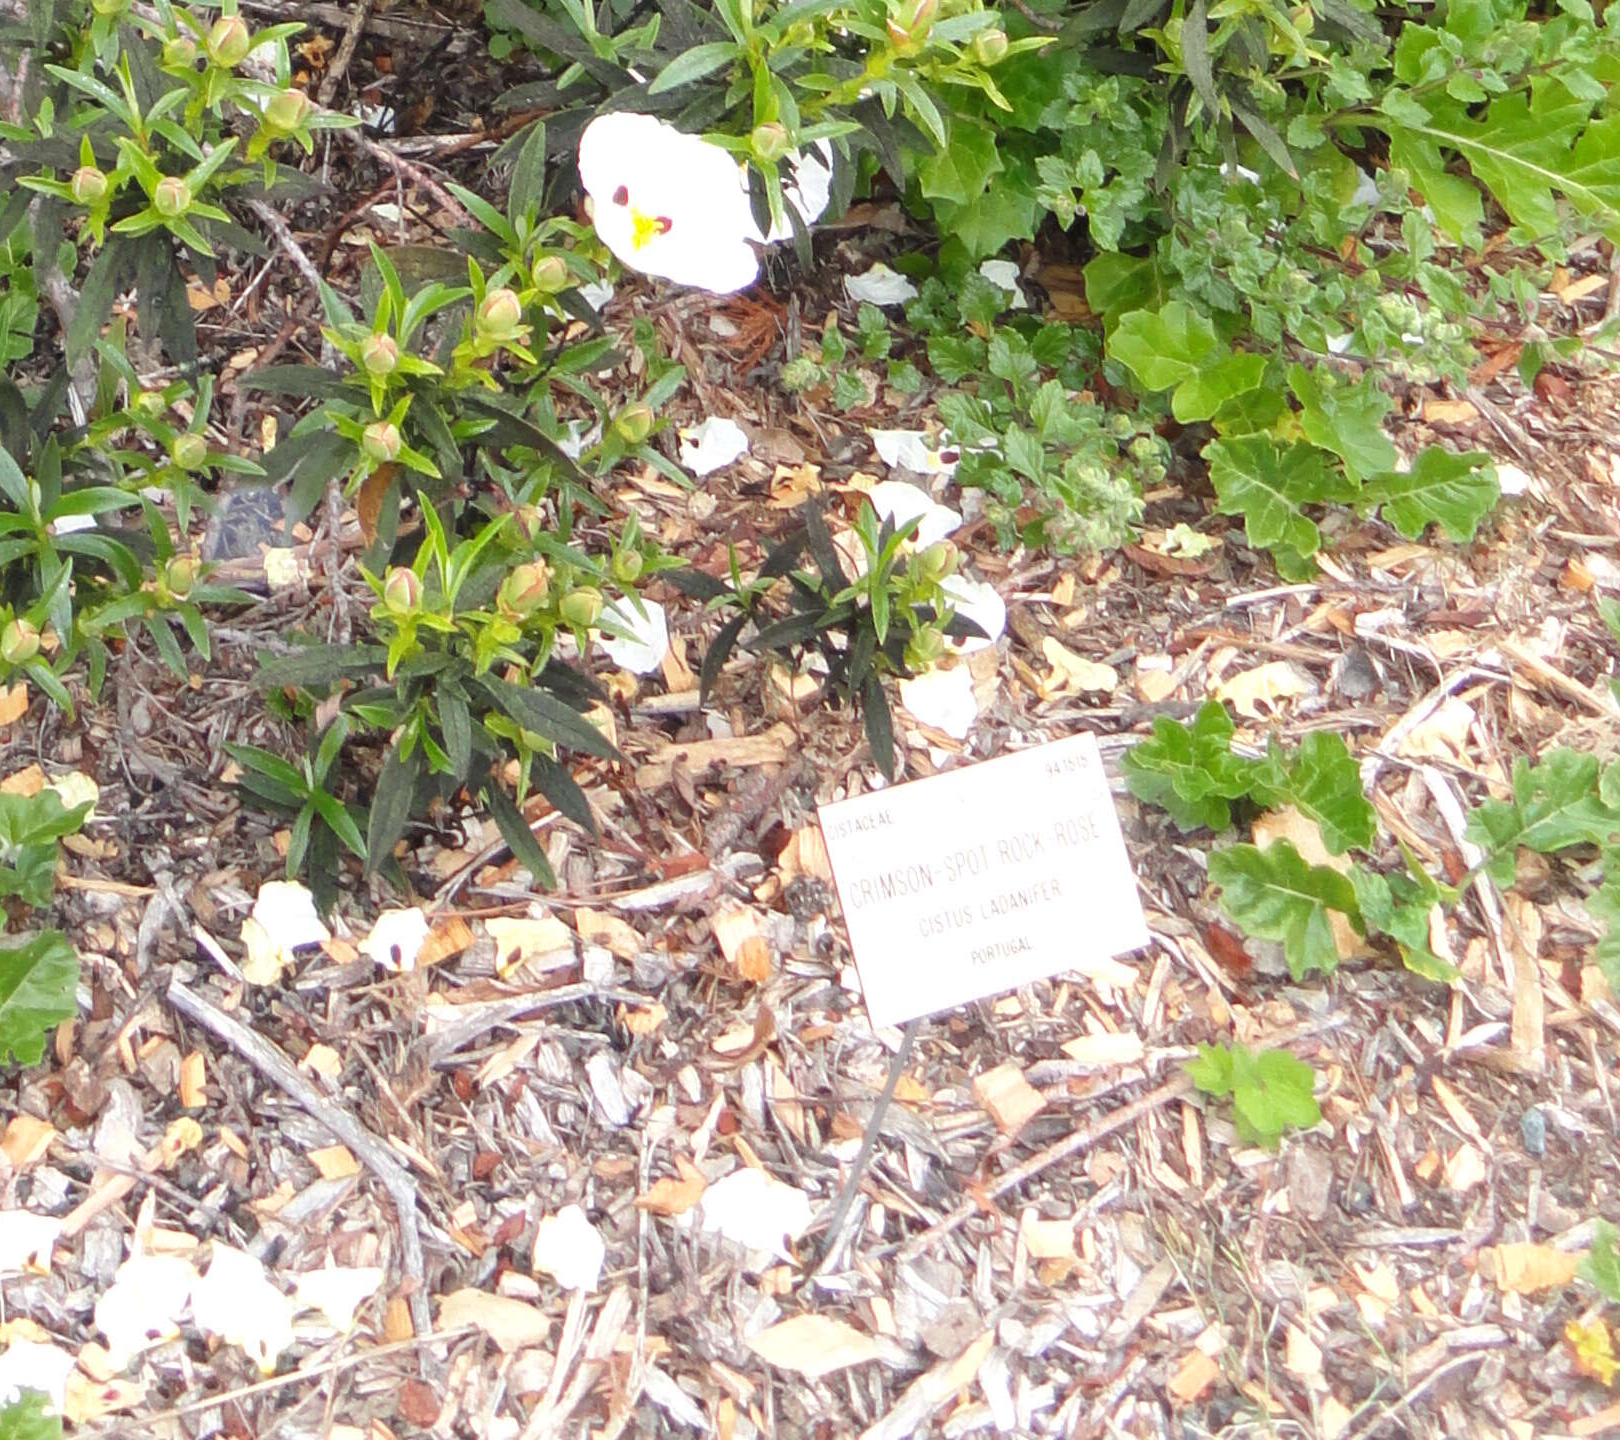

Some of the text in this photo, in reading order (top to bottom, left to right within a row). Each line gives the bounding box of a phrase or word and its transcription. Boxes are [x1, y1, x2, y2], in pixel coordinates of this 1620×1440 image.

[827, 809, 893, 840] CISTACEAE
[849, 814, 1101, 909] CRIMSON-SPOT ROCK-ROSE
[918, 878, 1062, 938] CISTUS LADANIFER
[971, 936, 1032, 965] PORTUGAL
